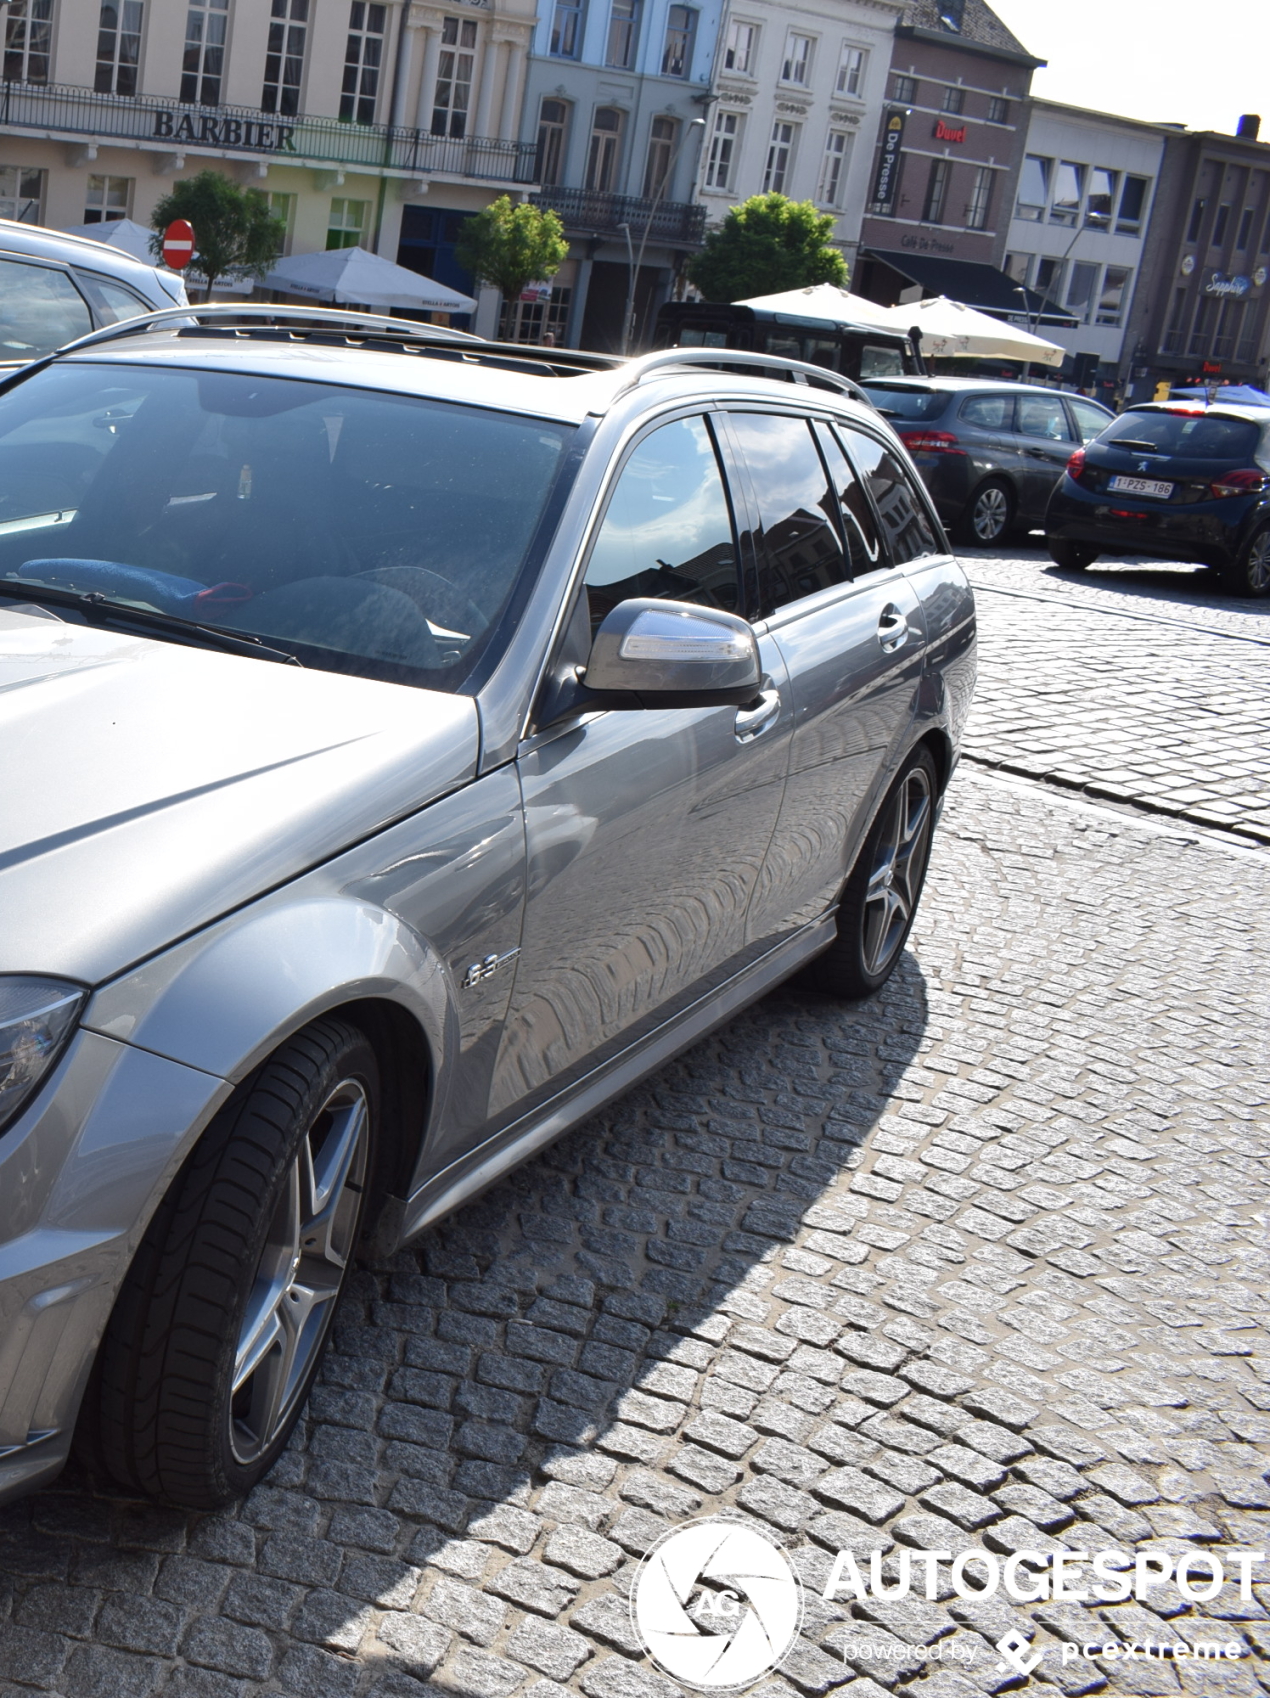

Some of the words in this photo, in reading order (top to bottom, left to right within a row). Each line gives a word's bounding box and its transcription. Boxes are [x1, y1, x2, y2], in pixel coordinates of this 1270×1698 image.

[152, 111, 297, 151] BARBIER
[885, 133, 899, 151] De
[935, 120, 967, 143] Duvel
[877, 154, 895, 200] Presse
[1205, 273, 1245, 297] Sapphire
